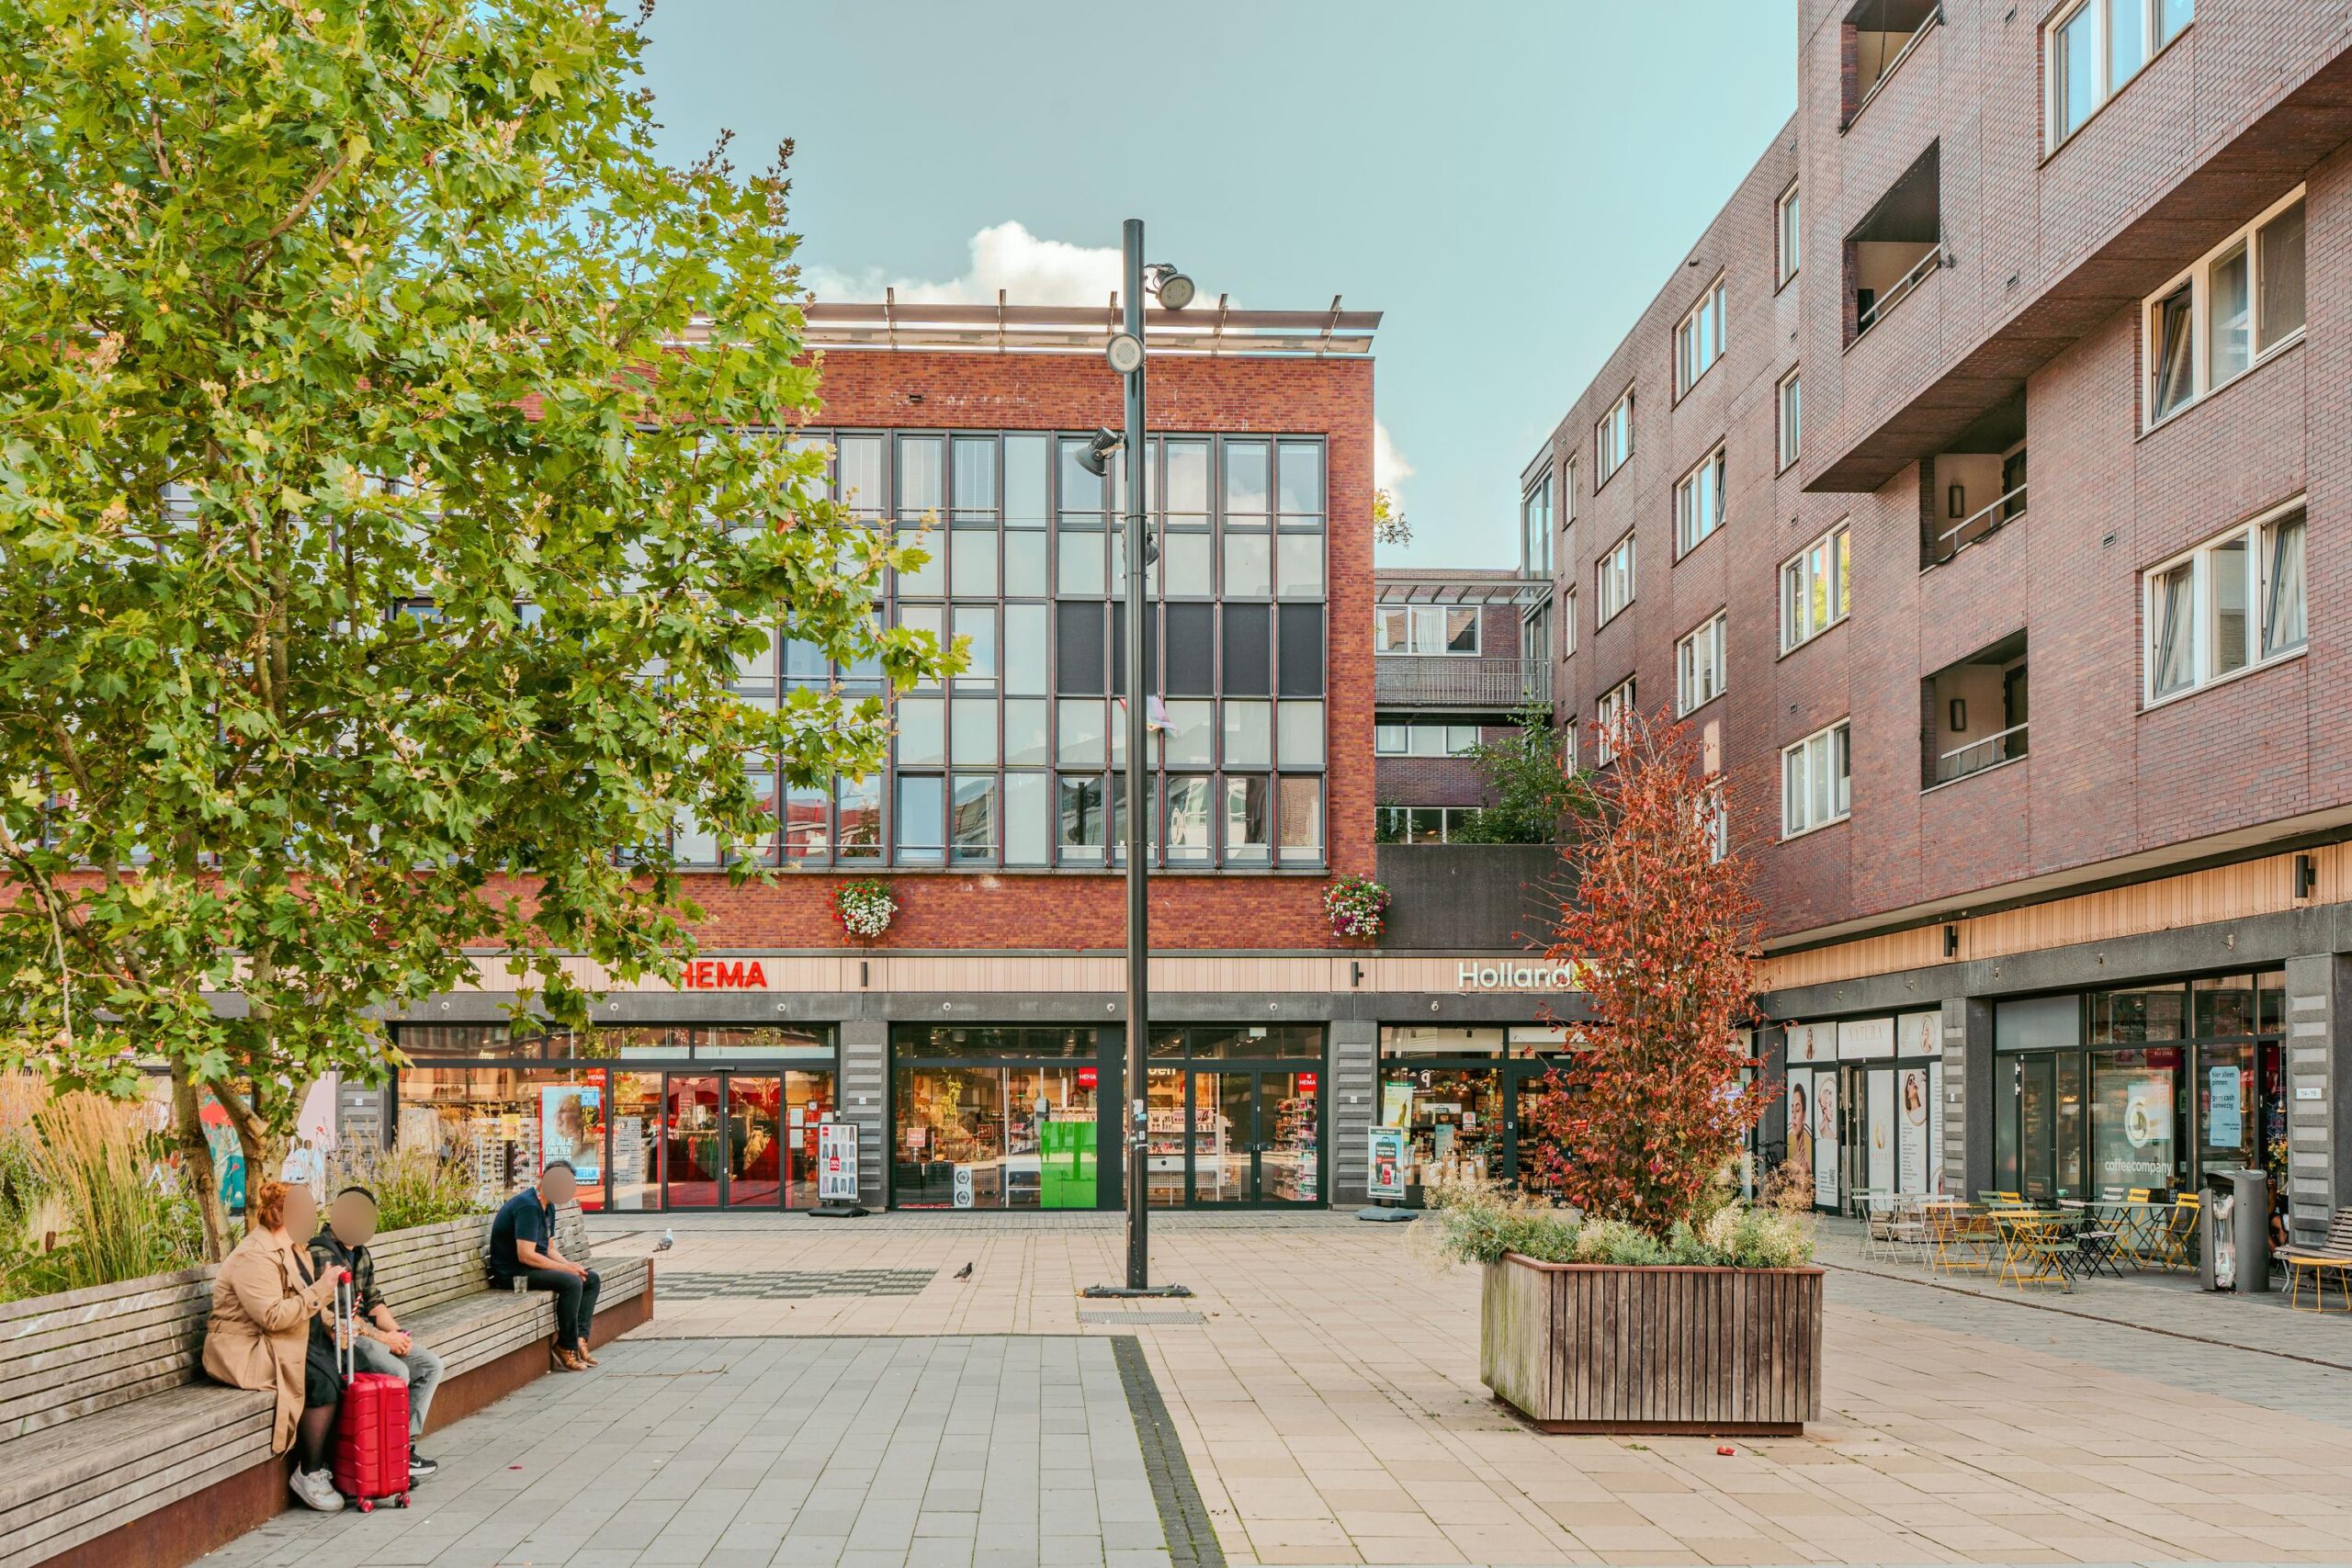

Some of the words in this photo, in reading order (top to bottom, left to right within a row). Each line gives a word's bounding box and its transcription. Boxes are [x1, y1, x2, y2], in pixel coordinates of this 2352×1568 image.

[678, 962, 767, 987] HEMA
[1458, 962, 1570, 988] Holland
[2105, 1158, 2173, 1177] coffeecompany
